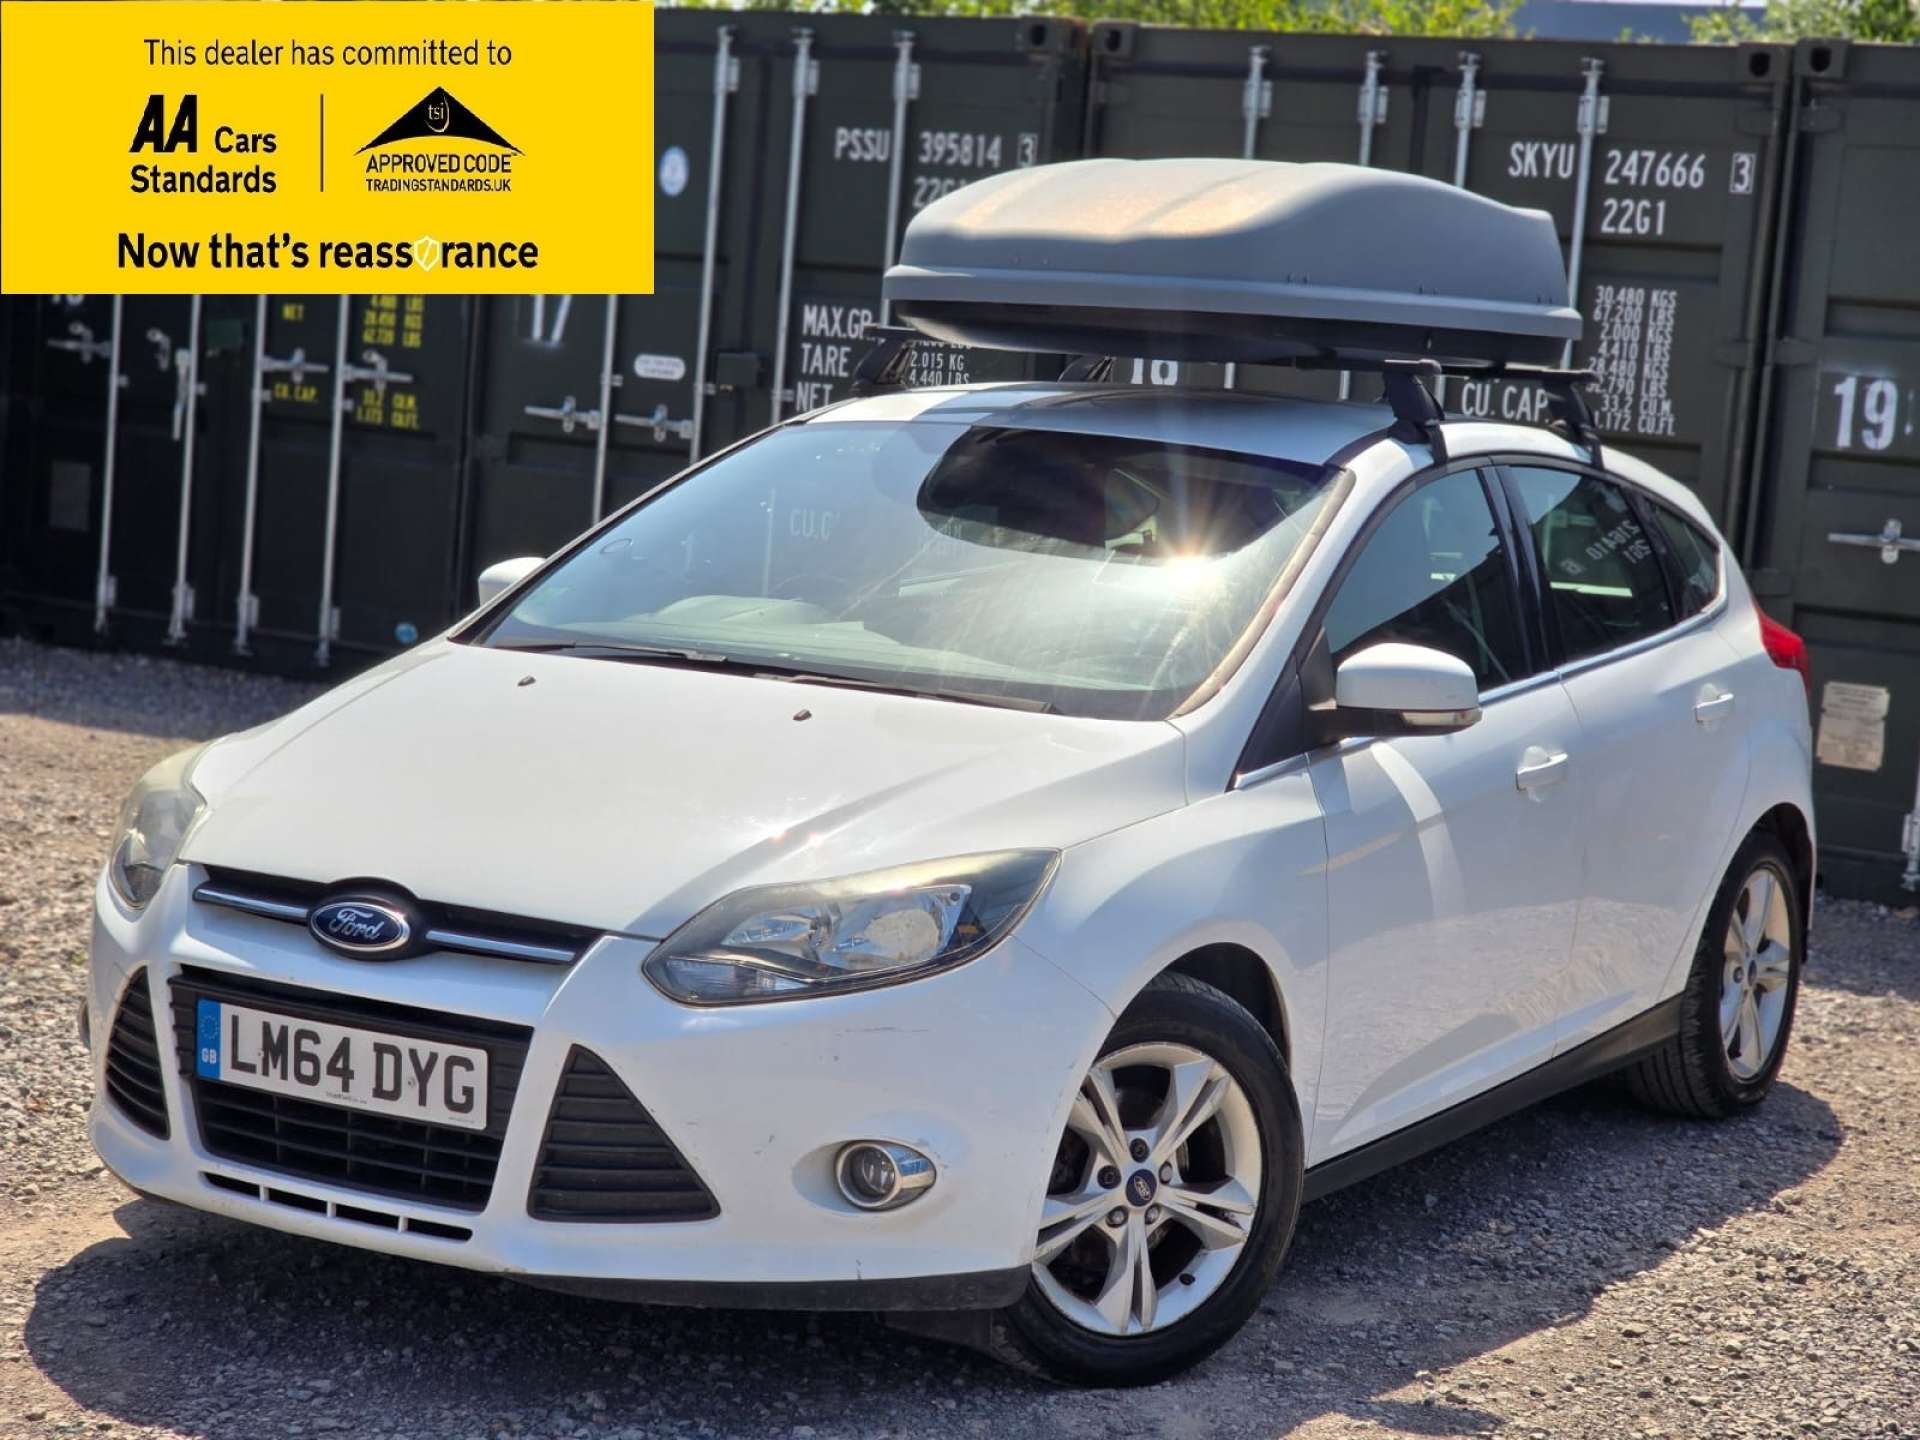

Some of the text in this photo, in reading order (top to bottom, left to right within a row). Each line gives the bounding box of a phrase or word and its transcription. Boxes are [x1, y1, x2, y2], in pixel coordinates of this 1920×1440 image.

[834, 127, 1035, 168] PSSU 395814 3
[1508, 141, 1752, 192] SKYU 247666 3
[1601, 199, 1665, 236] 22G1
[1596, 285, 1677, 309] 30.480 KGS
[1593, 304, 1675, 326] 67.200 LBS
[1647, 322, 1673, 343] KGS
[800, 343, 852, 378] TARE
[910, 351, 965, 371] 2.015 KG
[1645, 341, 1671, 362] LBS
[1601, 394, 1633, 413] 33.2
[1834, 377, 1898, 450] 19
[328, 907, 386, 940] Ford
[201, 1047, 217, 1065] GB
[230, 1014, 475, 1114] LM64 DYG
